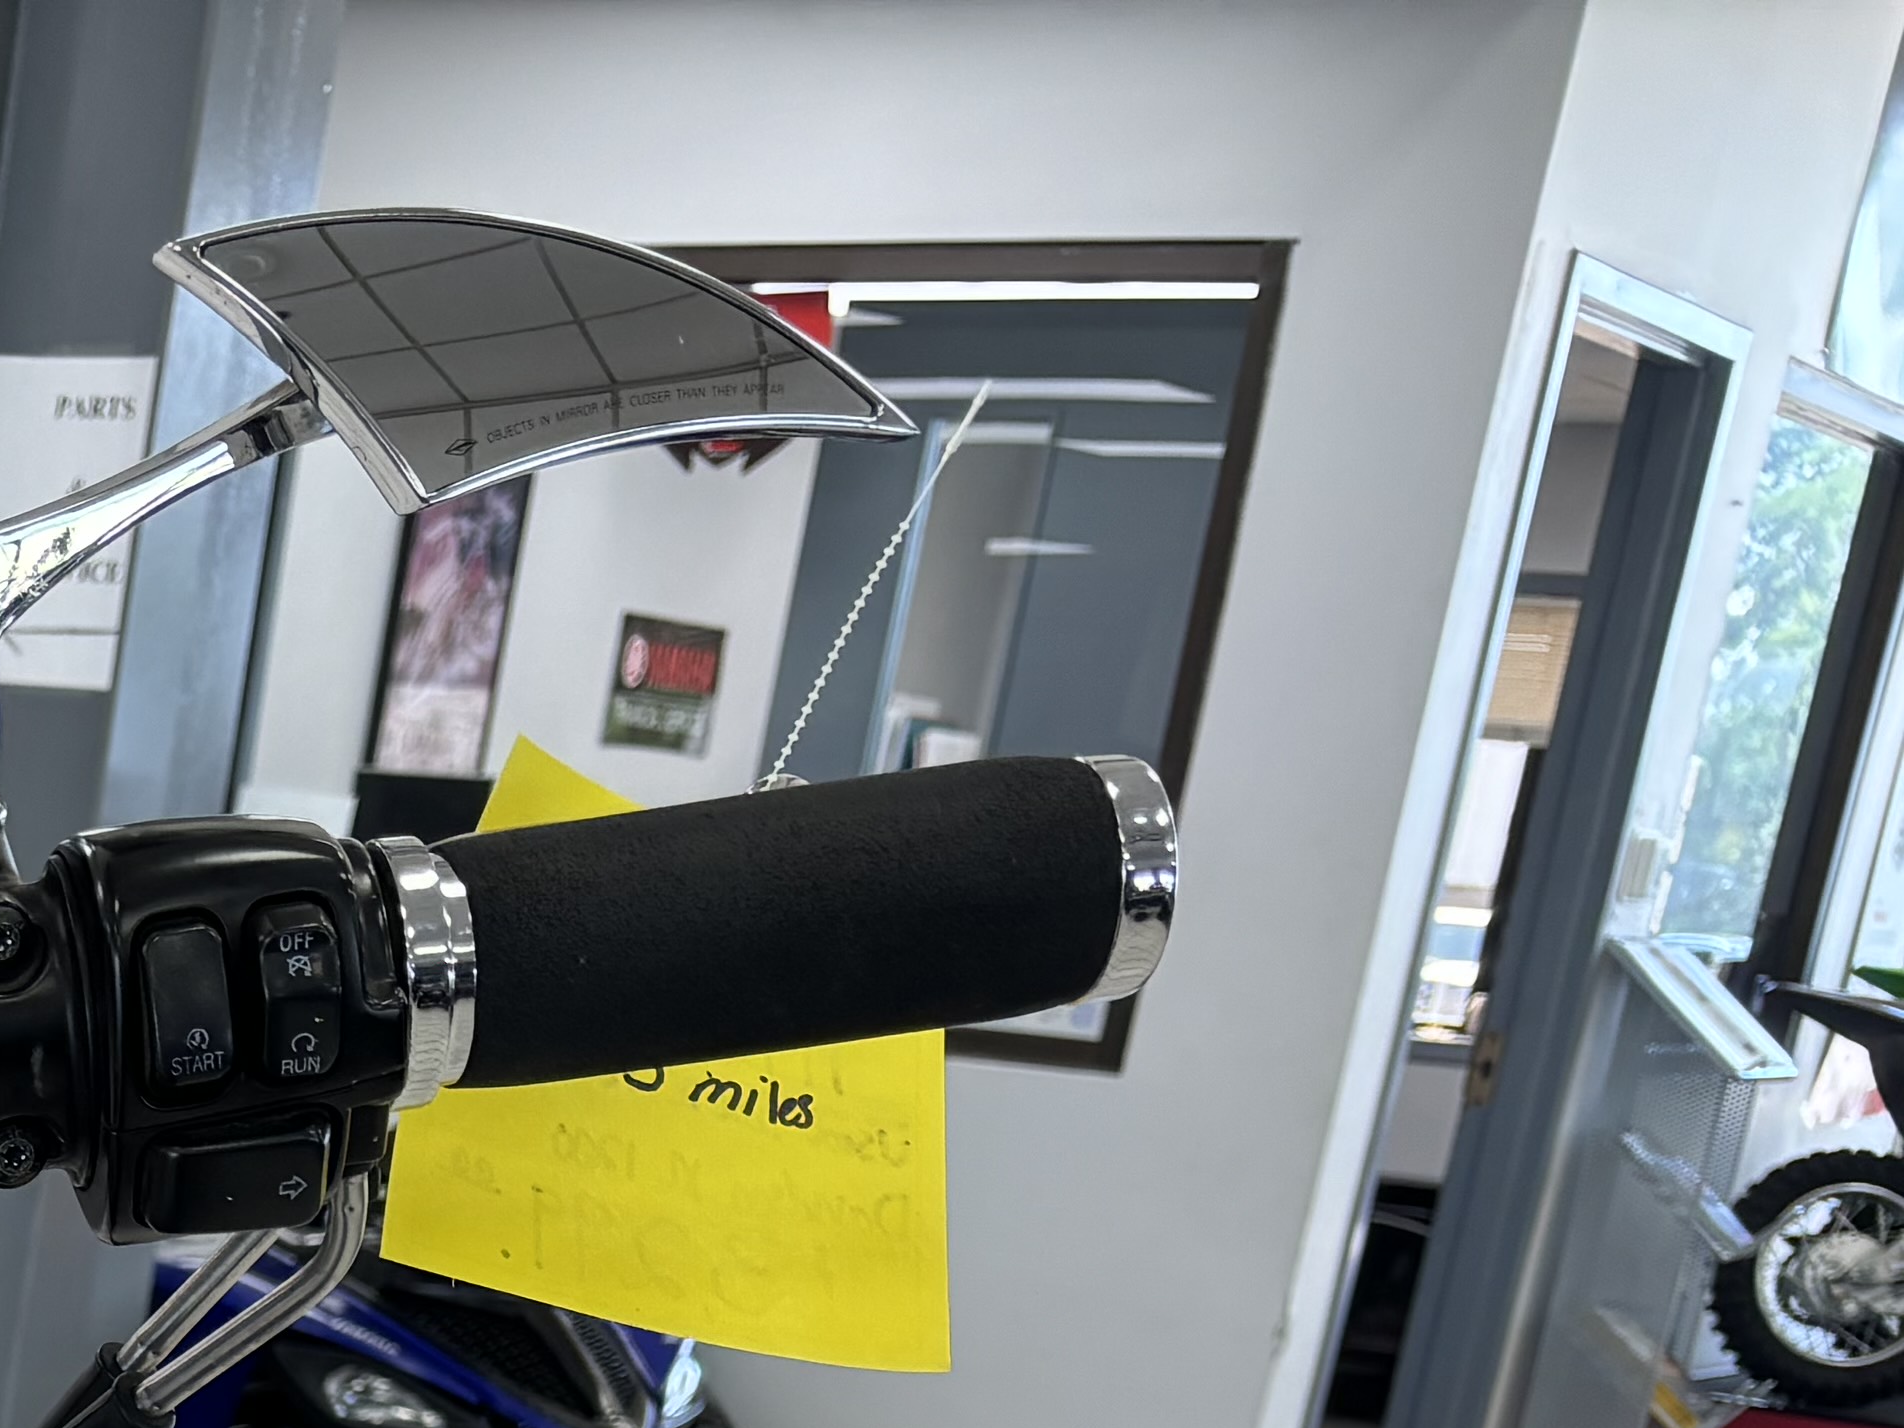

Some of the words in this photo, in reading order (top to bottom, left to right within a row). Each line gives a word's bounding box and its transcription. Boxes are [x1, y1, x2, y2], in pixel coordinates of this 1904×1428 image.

[53, 394, 137, 421] PARTS
[486, 419, 535, 444] OBJECTS
[540, 415, 552, 426] IN
[556, 402, 600, 423] MIRROR
[629, 389, 671, 408] CLOSER
[677, 385, 707, 400] THAN
[712, 384, 738, 398] THEY
[743, 383, 785, 397] APPEAR
[279, 932, 314, 952] OFF
[170, 1051, 225, 1076] START
[281, 1056, 321, 1075] RUN
[688, 1071, 815, 1129] miles
